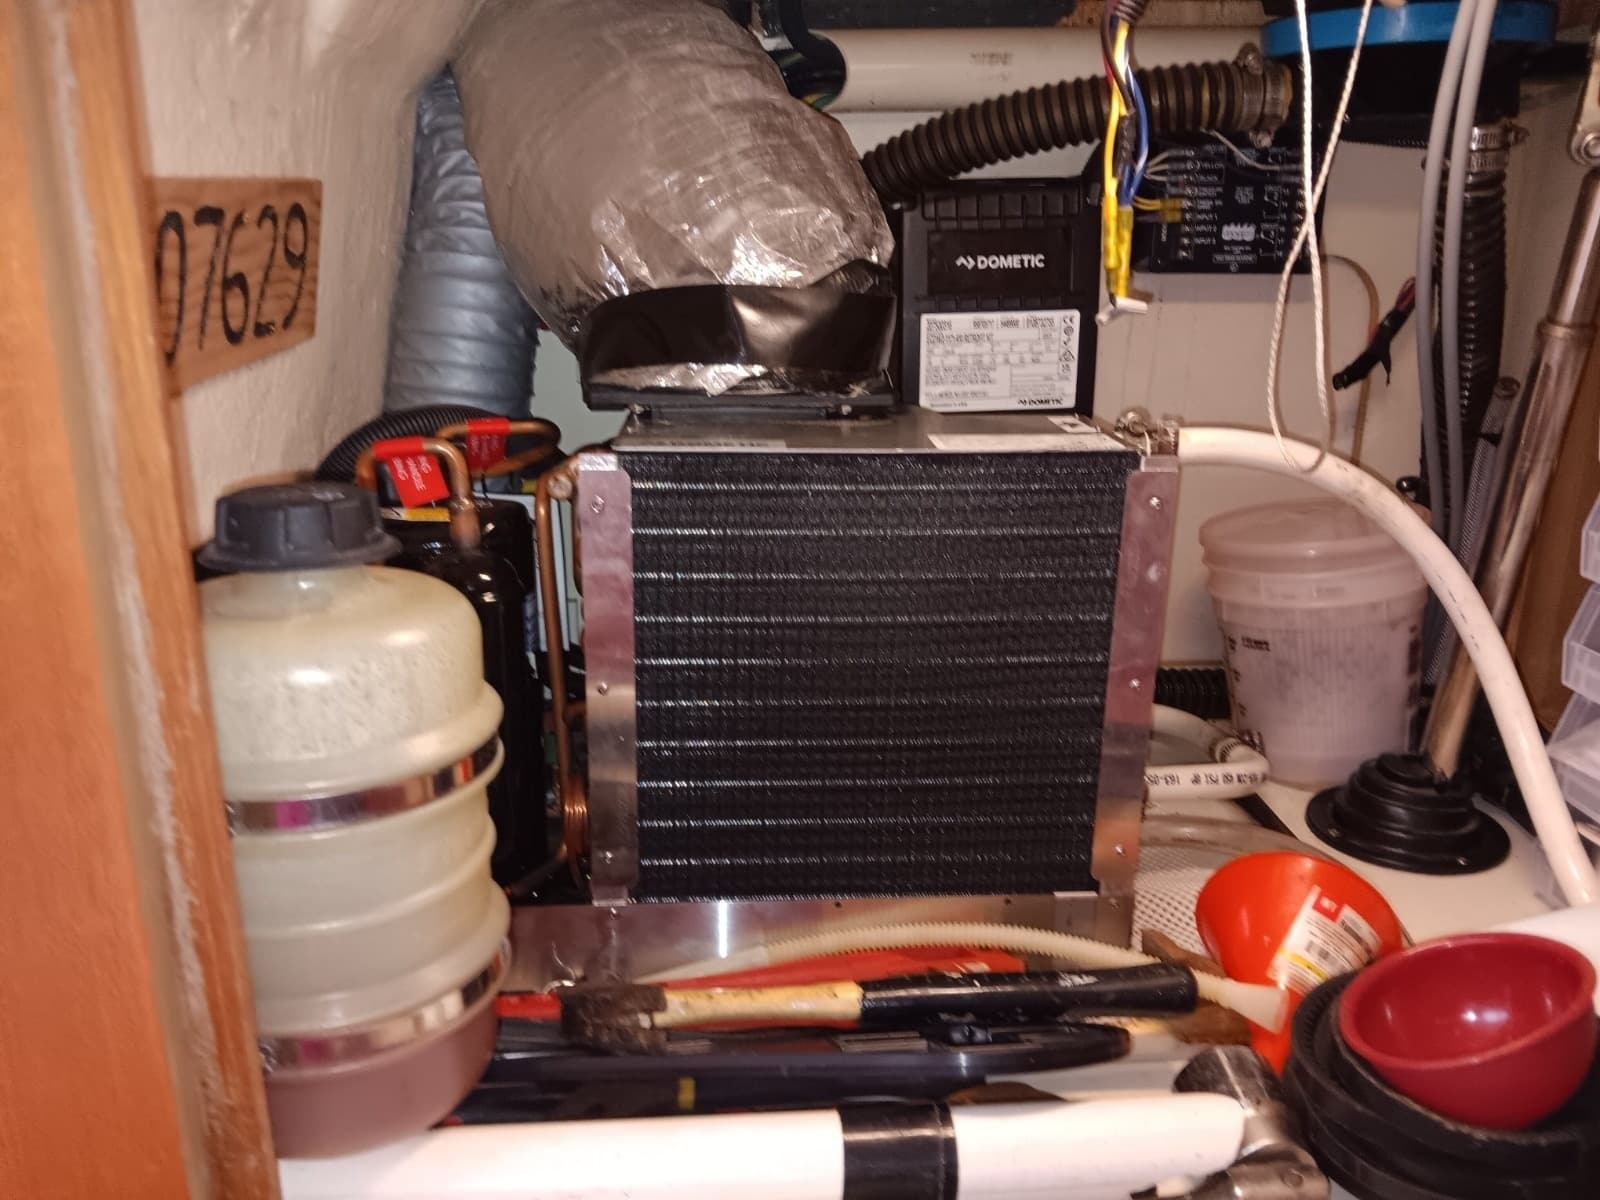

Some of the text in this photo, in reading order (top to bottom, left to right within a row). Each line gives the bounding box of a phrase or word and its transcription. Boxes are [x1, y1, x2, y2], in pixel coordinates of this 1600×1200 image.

[977, 253, 1045, 270] DOMETIC
[155, 203, 307, 367] 07629
[1028, 398, 1063, 406] DOMETIC
